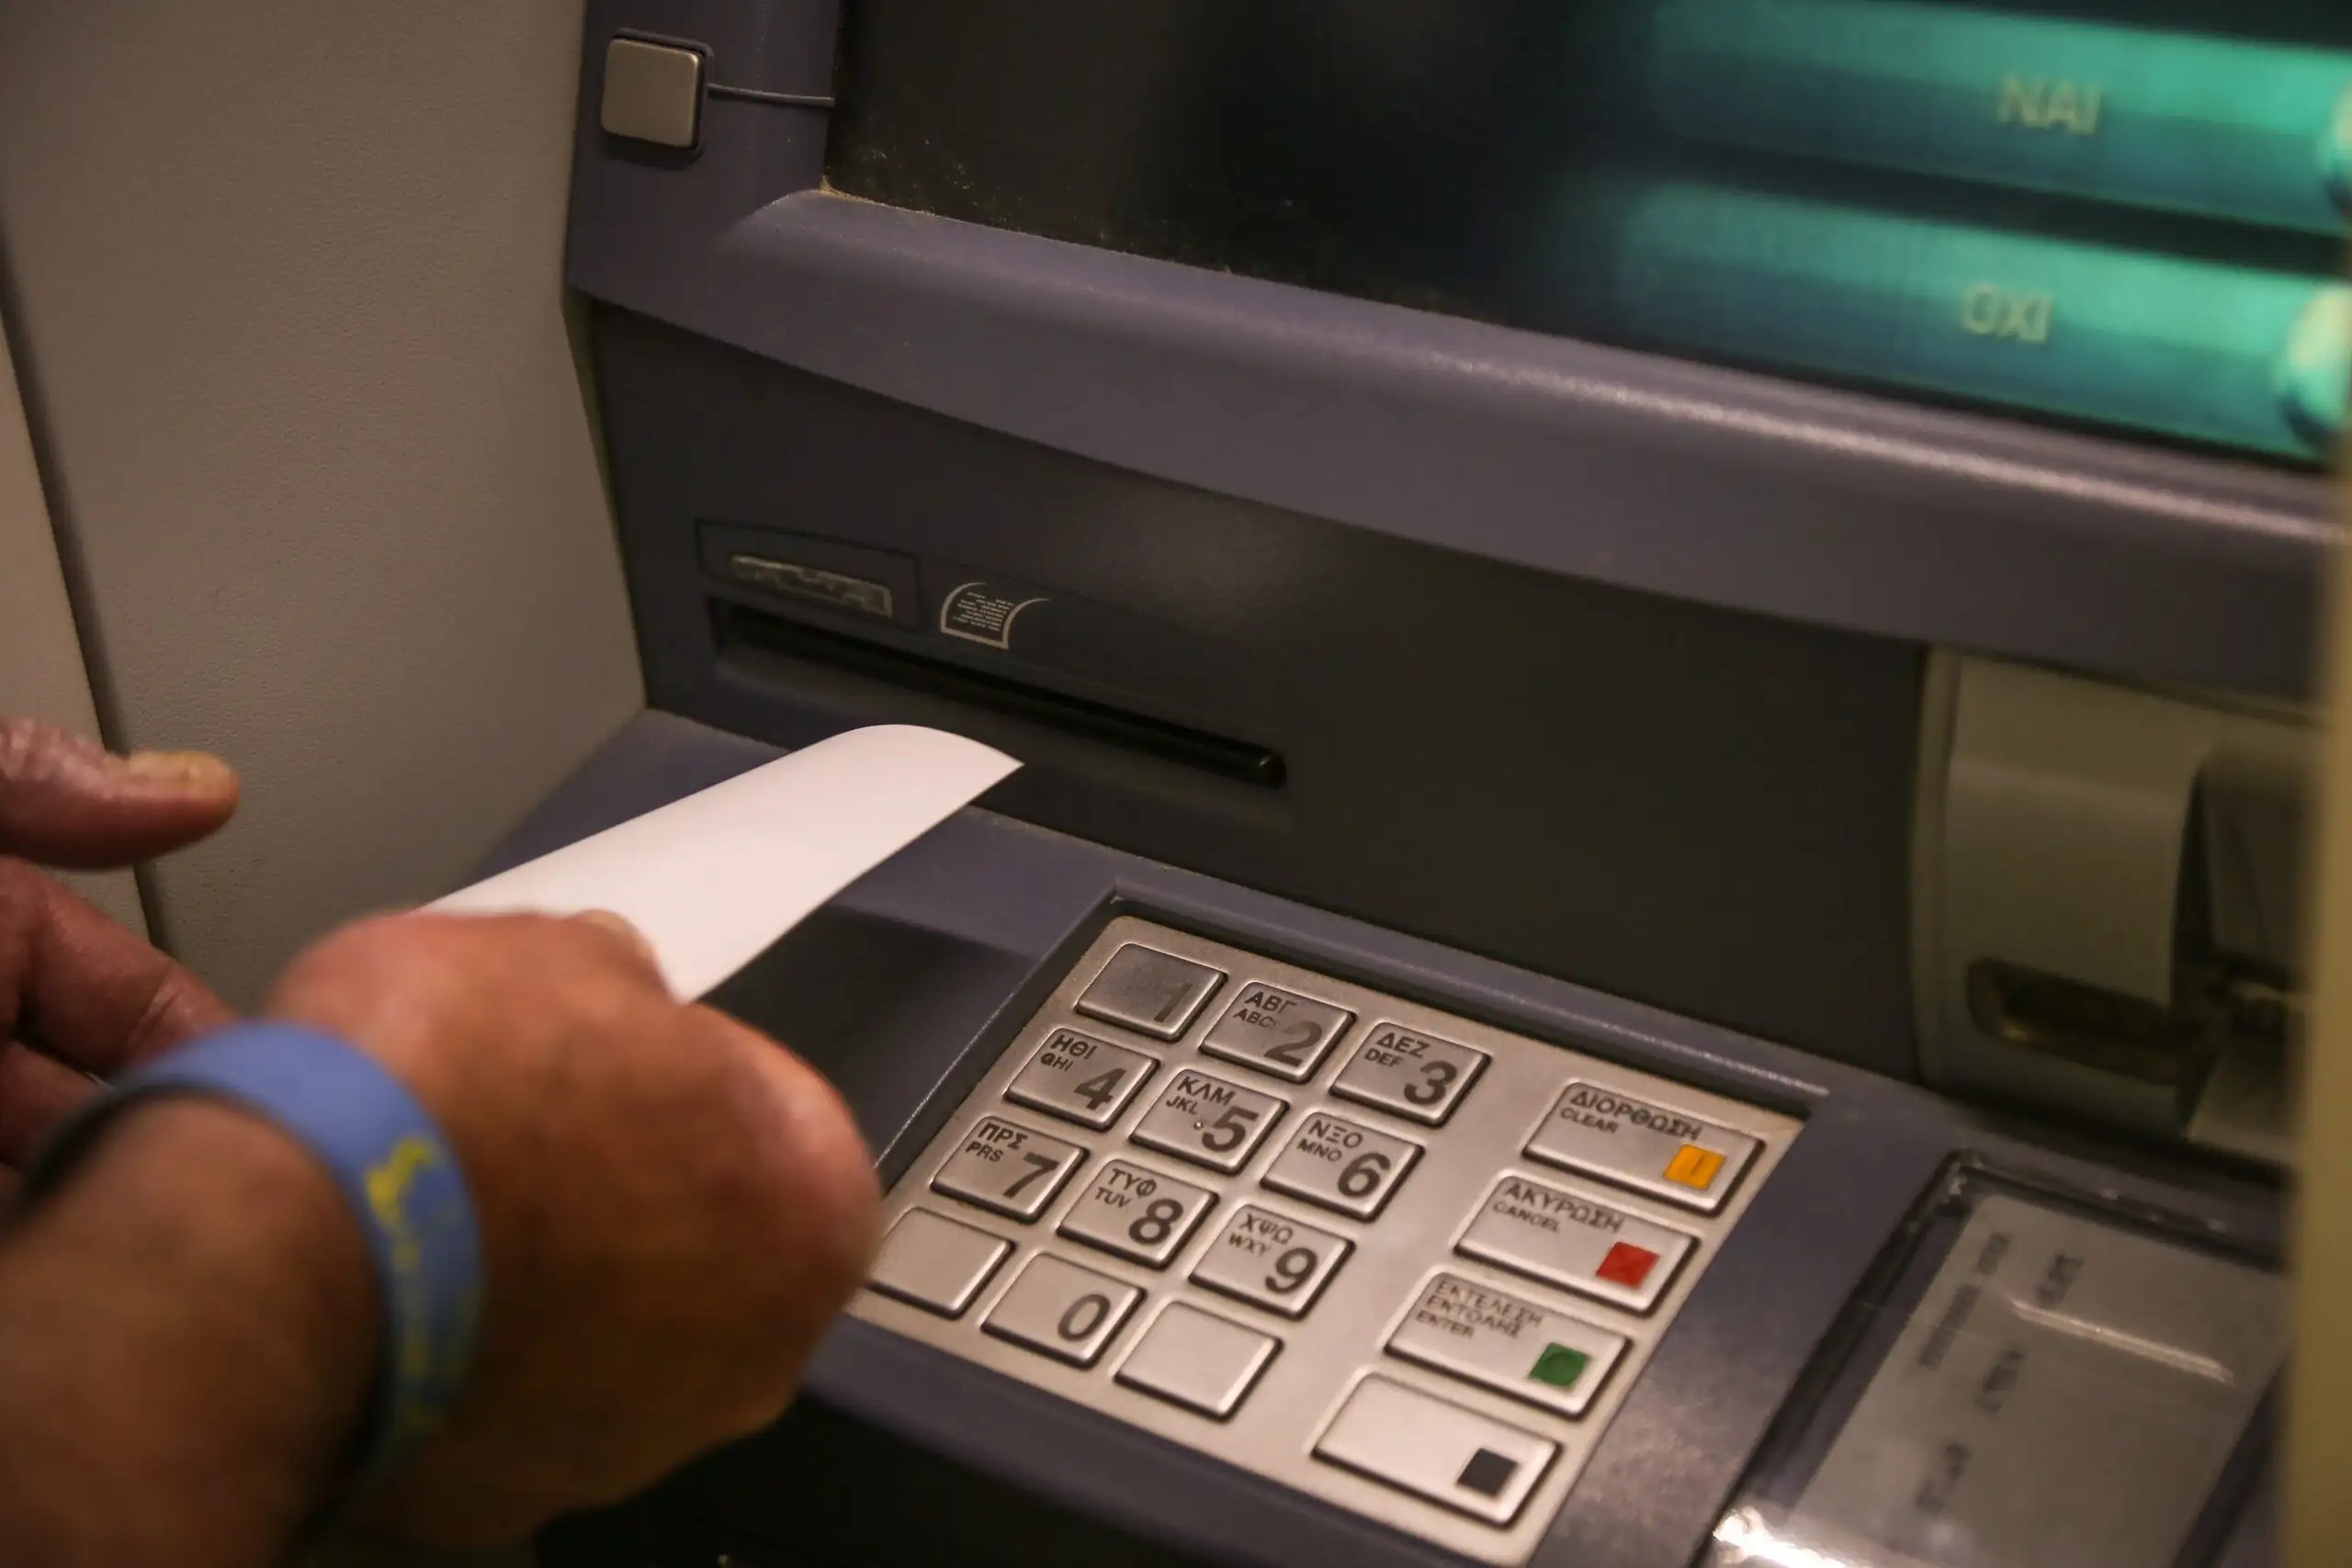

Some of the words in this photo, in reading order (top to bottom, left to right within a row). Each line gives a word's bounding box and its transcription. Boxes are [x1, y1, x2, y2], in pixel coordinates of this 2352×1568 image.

[1152, 982, 1193, 1023] 1
[1244, 990, 1298, 1013] ΑΒΓ
[1050, 1033, 1098, 1060] ΗΘΙ
[1262, 1020, 1323, 1067] 2
[1364, 1047, 1404, 1068] DEF
[1375, 1032, 1430, 1058] ΔΕΖ
[1073, 1067, 1128, 1111] 4
[1177, 1076, 1236, 1106] ΚΛΜ
[1404, 1060, 1458, 1106] 3
[1166, 1095, 1199, 1115] JKL
[1559, 1106, 1620, 1135] CLEAR
[1569, 1090, 1703, 1141] ΔΙΟΡΘΩΣΗ
[977, 1122, 1029, 1150] ΠΡΣ
[1201, 1105, 1261, 1153] 5
[1308, 1119, 1363, 1149] ΝΞΟ
[965, 1140, 1004, 1163] PRS
[1296, 1138, 1343, 1163] MNO
[1002, 1150, 1060, 1199] 7
[1106, 1168, 1158, 1199] ΤΥΦ
[1337, 1152, 1392, 1198] 6
[1095, 1186, 1133, 1209] TUV
[1504, 1182, 1625, 1234] ΑΚΥΡΩΣΗ
[1128, 1198, 1184, 1246] 8
[1239, 1213, 1295, 1246] ΧΨΩ
[1493, 1201, 1560, 1233] CANCEL
[1228, 1233, 1272, 1257] WXY
[1264, 1247, 1318, 1295] 9
[1057, 1293, 1111, 1342] 0
